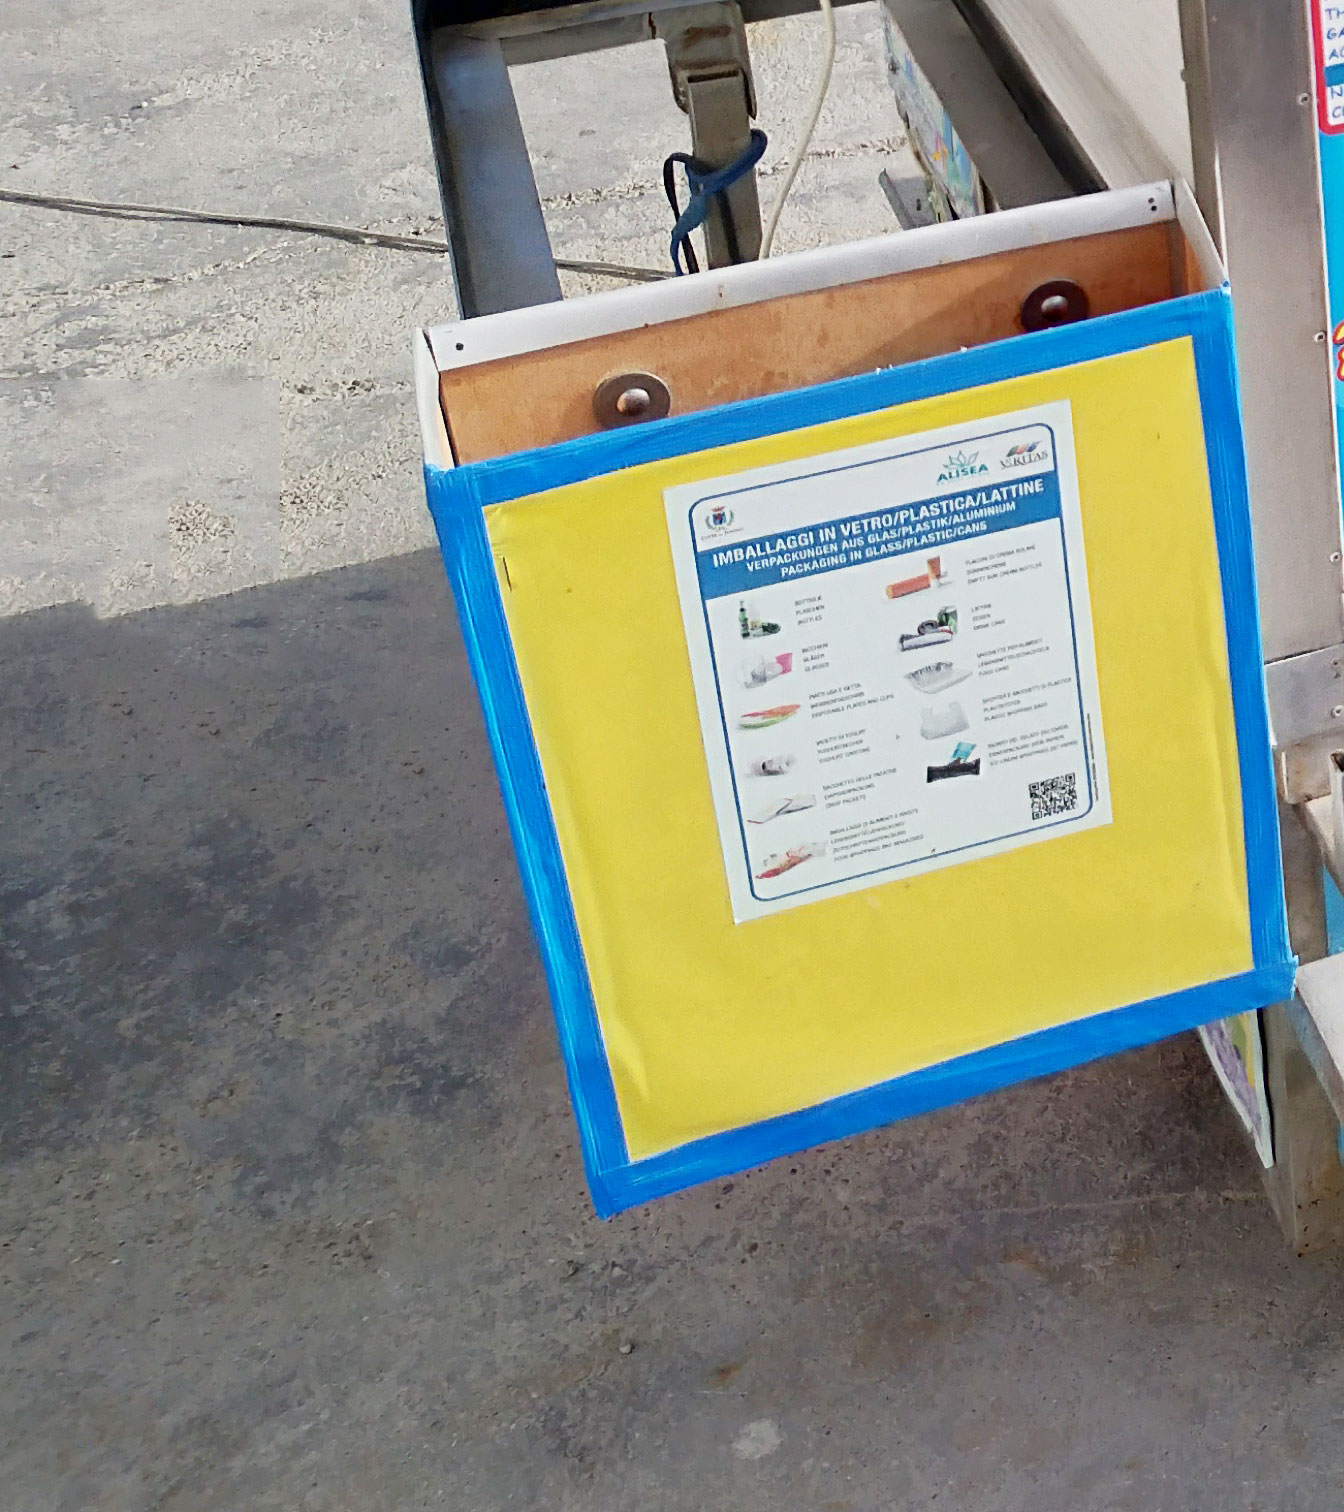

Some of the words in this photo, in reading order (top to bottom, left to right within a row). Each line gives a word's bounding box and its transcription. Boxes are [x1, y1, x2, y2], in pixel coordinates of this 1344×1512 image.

[937, 464, 989, 483] ALISEA
[712, 533, 814, 568] IMBALLAGGI
[820, 527, 836, 543] IN
[840, 478, 1045, 538] VETRO/PLASTICA/LATTINE
[781, 555, 847, 578] PACKAGING
[850, 551, 862, 561] IN
[865, 520, 987, 559] GLASS/PLASTIC/CANS
[841, 536, 865, 553] AUS
[867, 502, 1016, 546] GLAS/PLASTIK/ALUMINIUM
